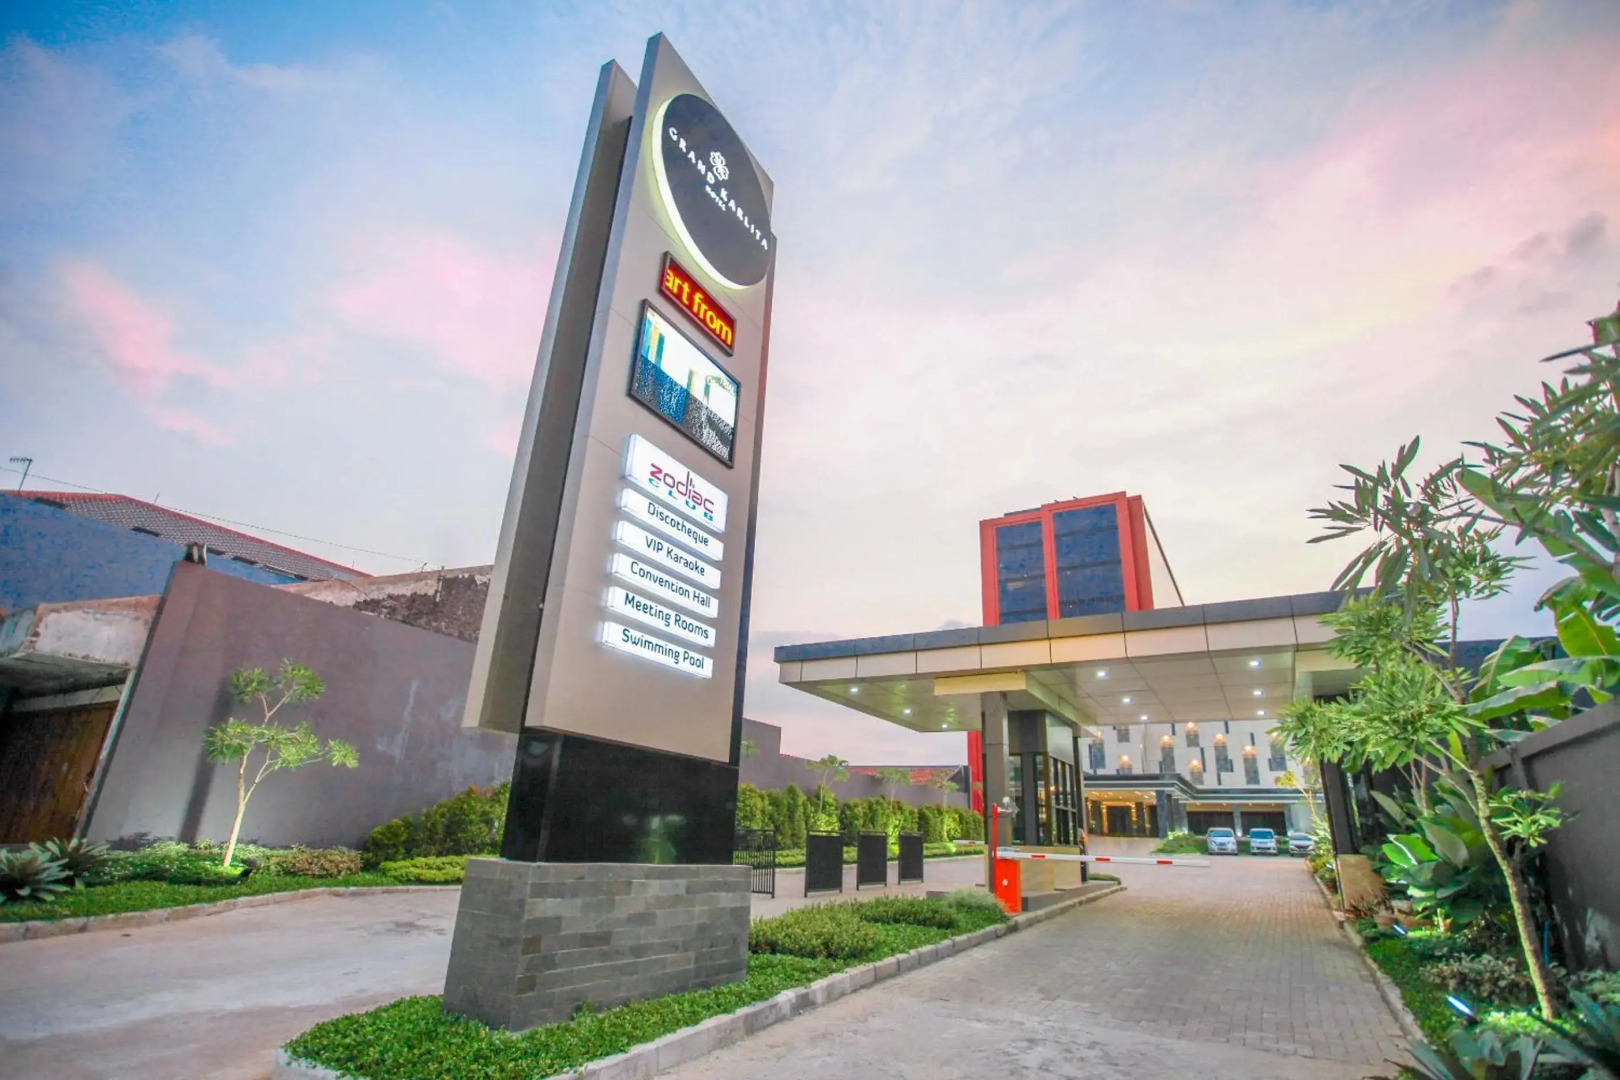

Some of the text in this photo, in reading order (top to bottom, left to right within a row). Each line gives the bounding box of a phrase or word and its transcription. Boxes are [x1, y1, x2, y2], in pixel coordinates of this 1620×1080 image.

[669, 127, 768, 250] GRAND KARLITA
[692, 292, 733, 346] from
[648, 477, 714, 522] CLUB
[649, 463, 715, 514] zodiac
[647, 502, 710, 547] Discotheque
[645, 535, 706, 577] VIP Karaoke
[630, 561, 711, 609] Convention Hall
[624, 592, 709, 640] Meeting Rooms
[621, 628, 704, 670] Swimming Pool
